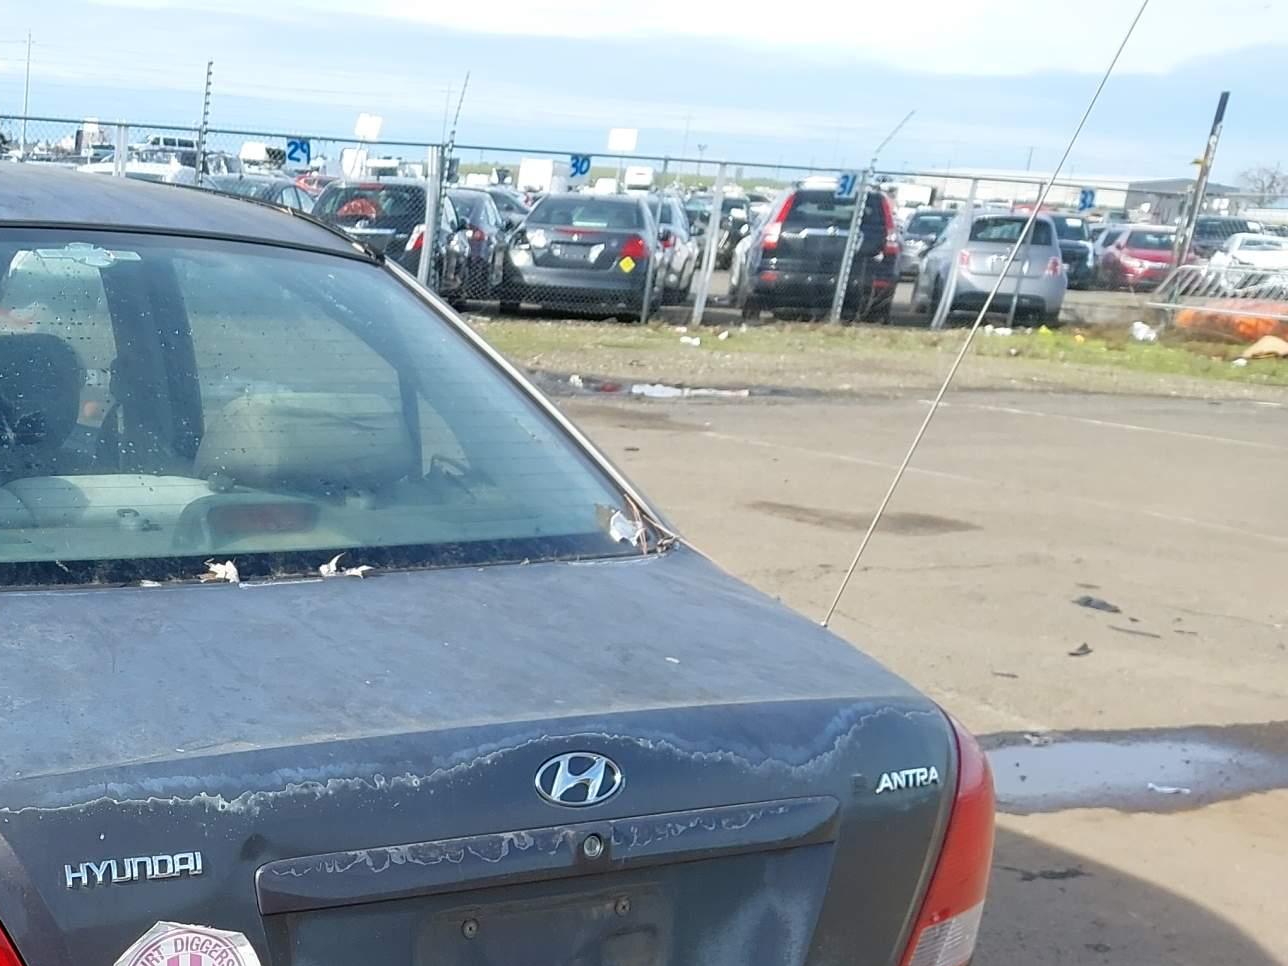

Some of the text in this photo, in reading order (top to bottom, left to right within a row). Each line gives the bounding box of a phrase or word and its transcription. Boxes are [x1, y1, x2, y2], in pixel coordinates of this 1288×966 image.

[287, 138, 311, 165] 29
[570, 154, 591, 178] 30
[838, 174, 857, 196] 31
[1079, 189, 1096, 211] 32
[875, 766, 940, 794] ANTRA
[64, 851, 203, 888] HYUNDAI
